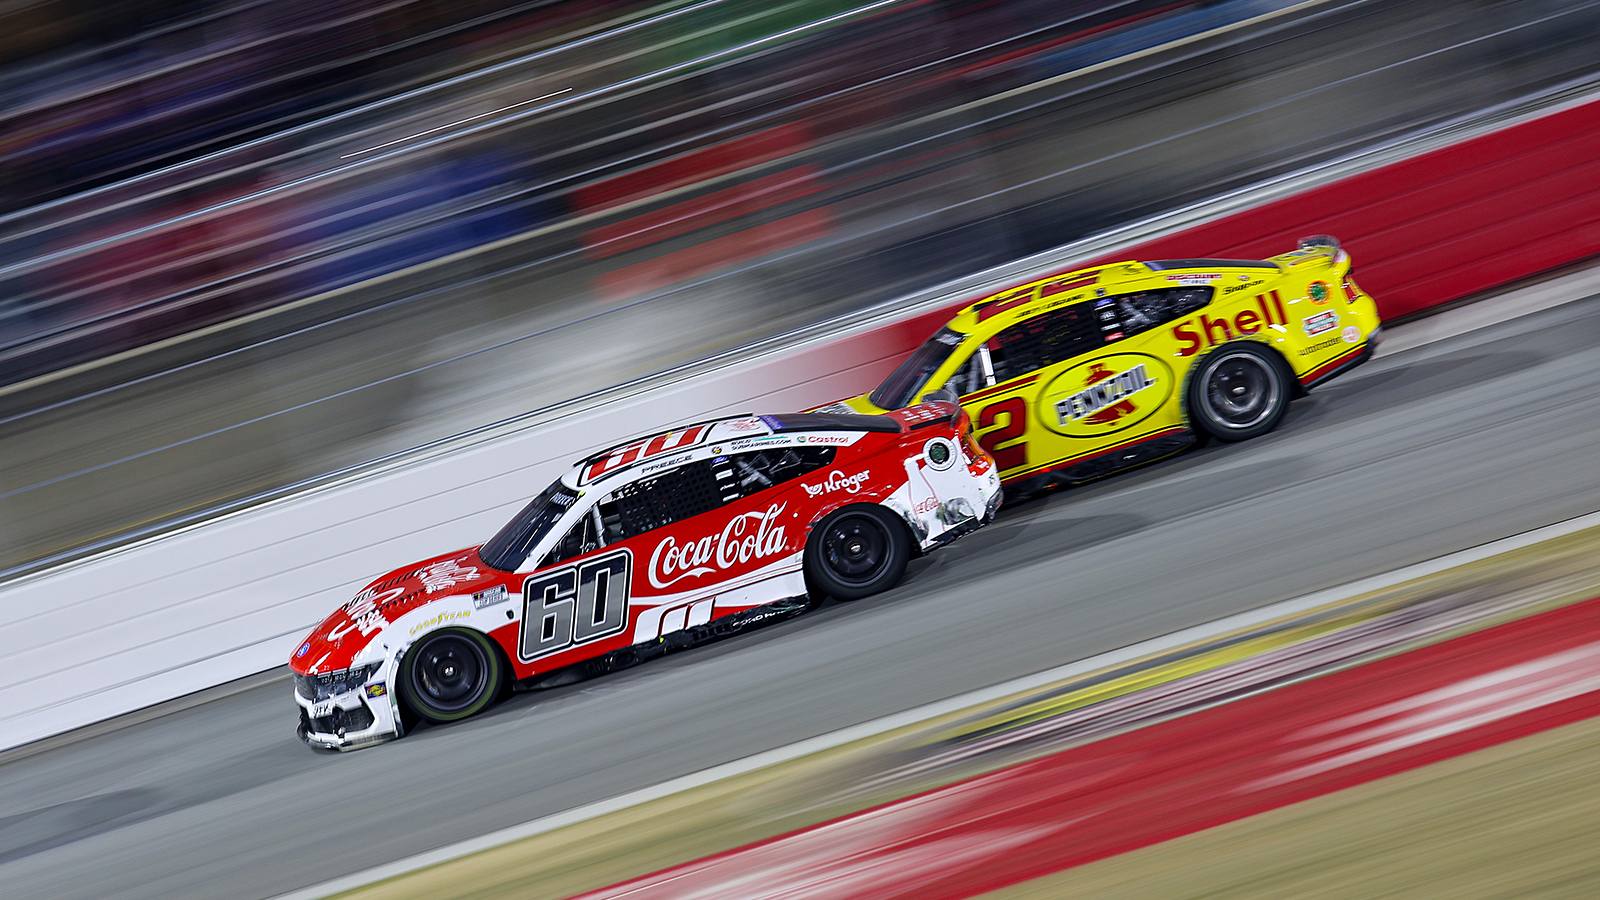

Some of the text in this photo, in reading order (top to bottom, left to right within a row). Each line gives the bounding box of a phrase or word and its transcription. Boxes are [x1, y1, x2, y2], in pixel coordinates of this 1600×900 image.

[1172, 290, 1290, 357] Shell
[1053, 362, 1156, 427] PENNZOIL
[586, 424, 707, 482] 60
[641, 454, 693, 474] PREECE
[808, 435, 849, 443] Castrol
[824, 469, 870, 493] Kroger
[648, 501, 788, 589] Coca-Cola
[409, 610, 471, 636] GOODYEAR
[519, 549, 632, 661] 60
